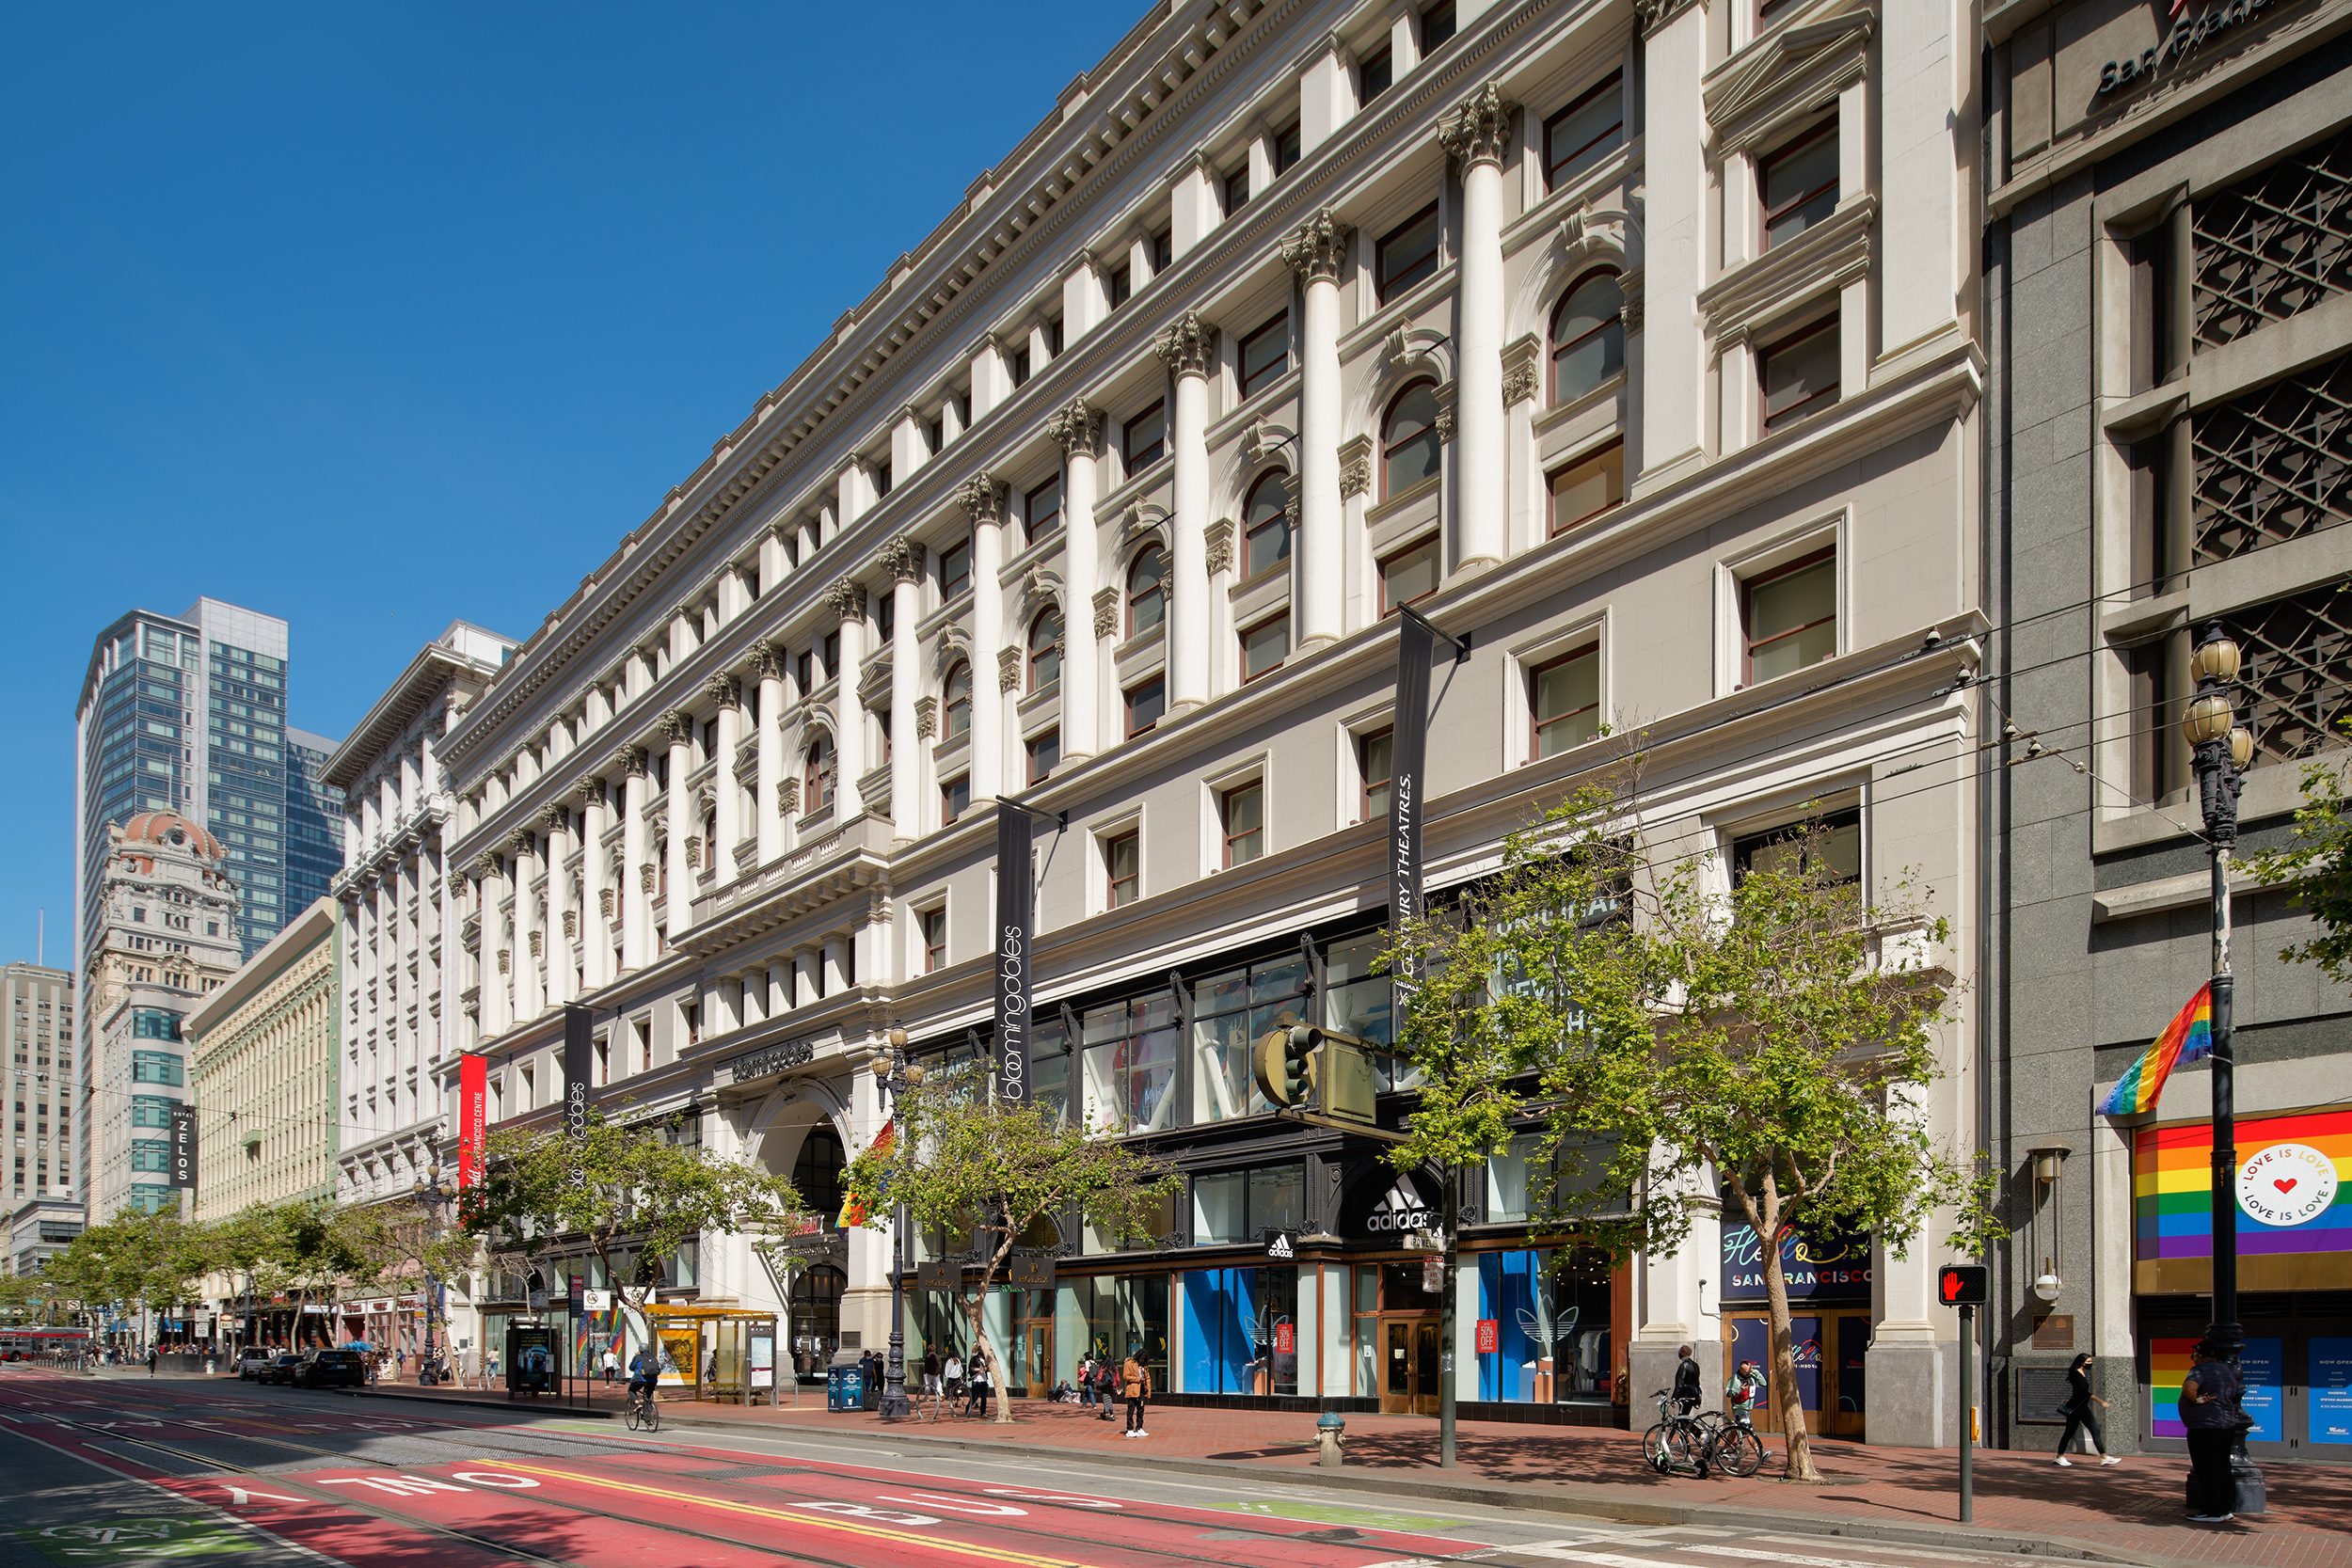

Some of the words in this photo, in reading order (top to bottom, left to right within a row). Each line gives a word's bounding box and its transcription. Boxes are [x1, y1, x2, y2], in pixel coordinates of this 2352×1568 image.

[2099, 47, 2157, 92] San
[474, 1091, 484, 1117] CENTRE
[178, 1120, 188, 1180] ZELOS
[2244, 1153, 2273, 1180] LOVE
[2279, 1148, 2292, 1158] IS
[2298, 1150, 2329, 1177] LOVE
[2245, 1195, 2274, 1219] LOVE
[2280, 1212, 2293, 1220] IS
[2298, 1190, 2328, 1217] LOVE
[1412, 1238, 1437, 1248] POWELL
[1268, 1246, 1294, 1259] adidas
[925, 1278, 955, 1287] ROLEX
[1018, 1275, 1049, 1284] ROLEX
[1732, 1274, 1765, 1287] SAN
[1784, 1269, 1872, 1285] RANCISCO
[1279, 1329, 1290, 1338] 50%
[1481, 1325, 1494, 1336] 50%
[1279, 1338, 1290, 1347] OFF
[1480, 1336, 1493, 1346] OFF
[785, 1488, 1124, 1527] BUS
